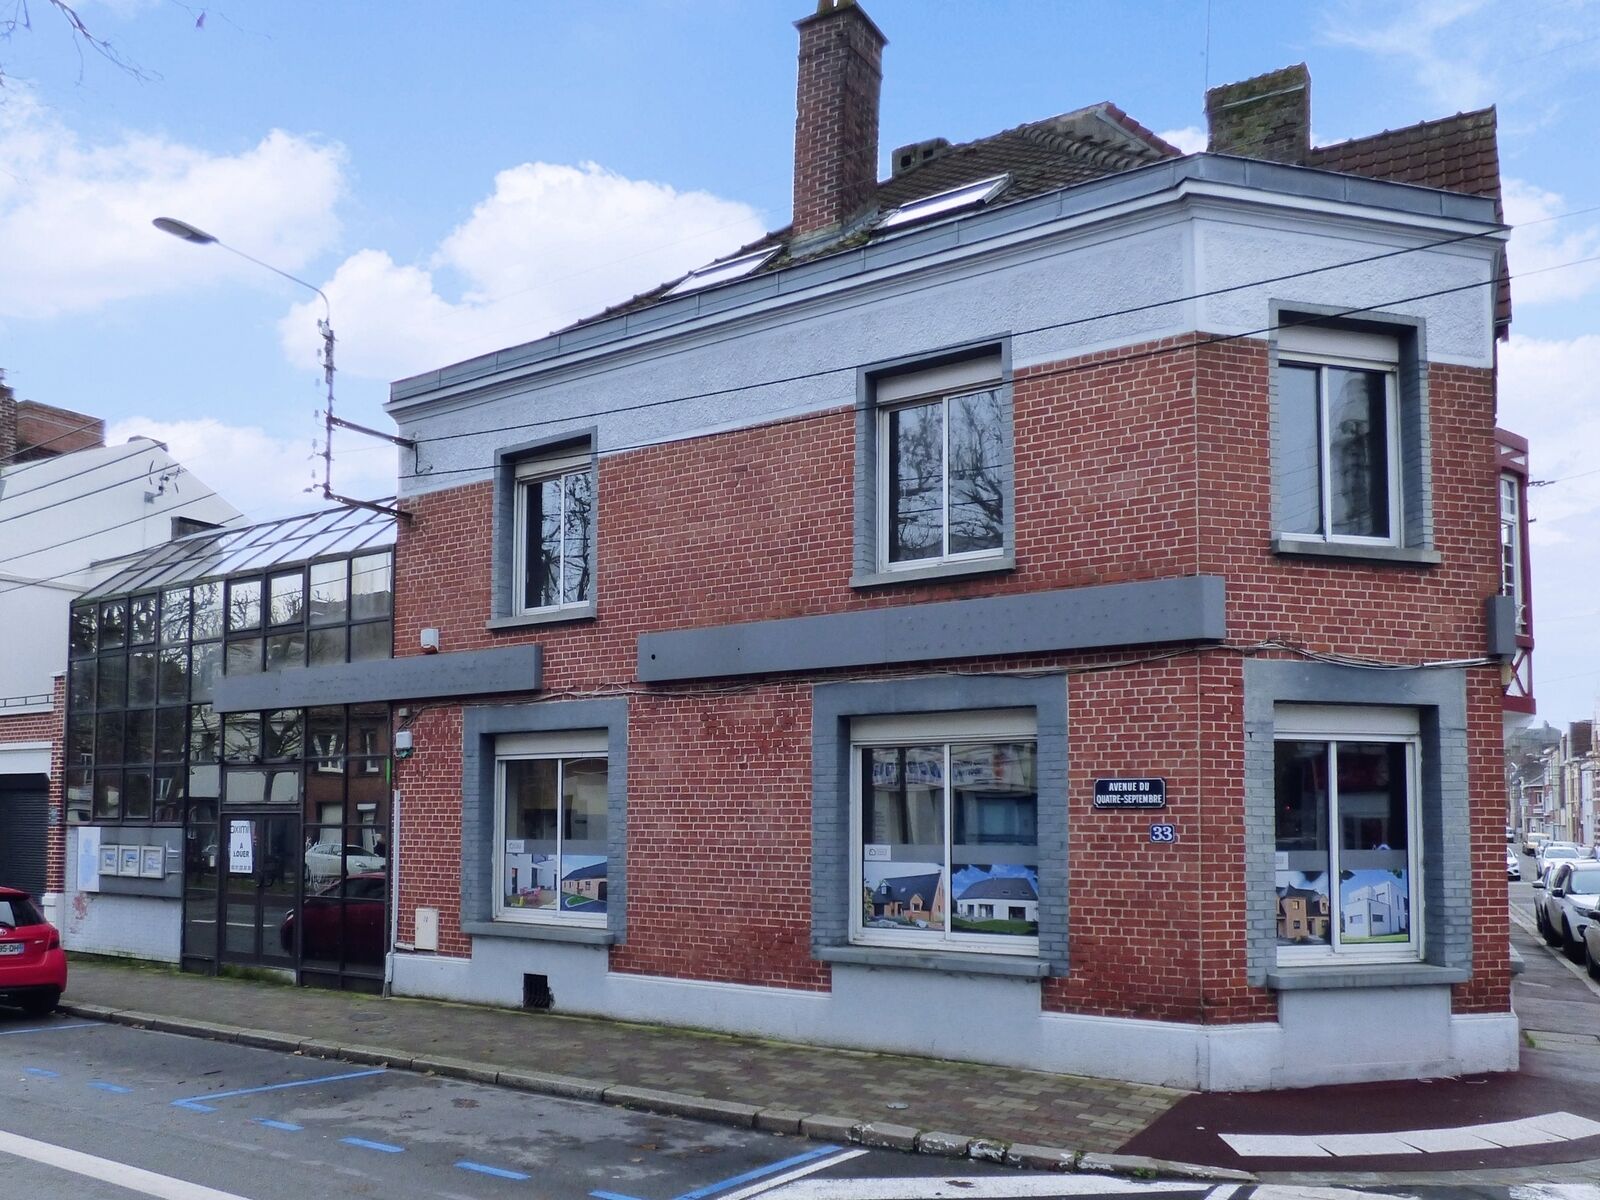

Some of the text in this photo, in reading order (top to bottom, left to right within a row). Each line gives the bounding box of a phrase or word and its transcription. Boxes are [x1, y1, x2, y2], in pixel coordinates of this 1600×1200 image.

[1109, 782, 1150, 791] AVENUE DU
[1096, 795, 1162, 804] QUATRE-SEPTEMBRE
[1152, 826, 1172, 841] 33
